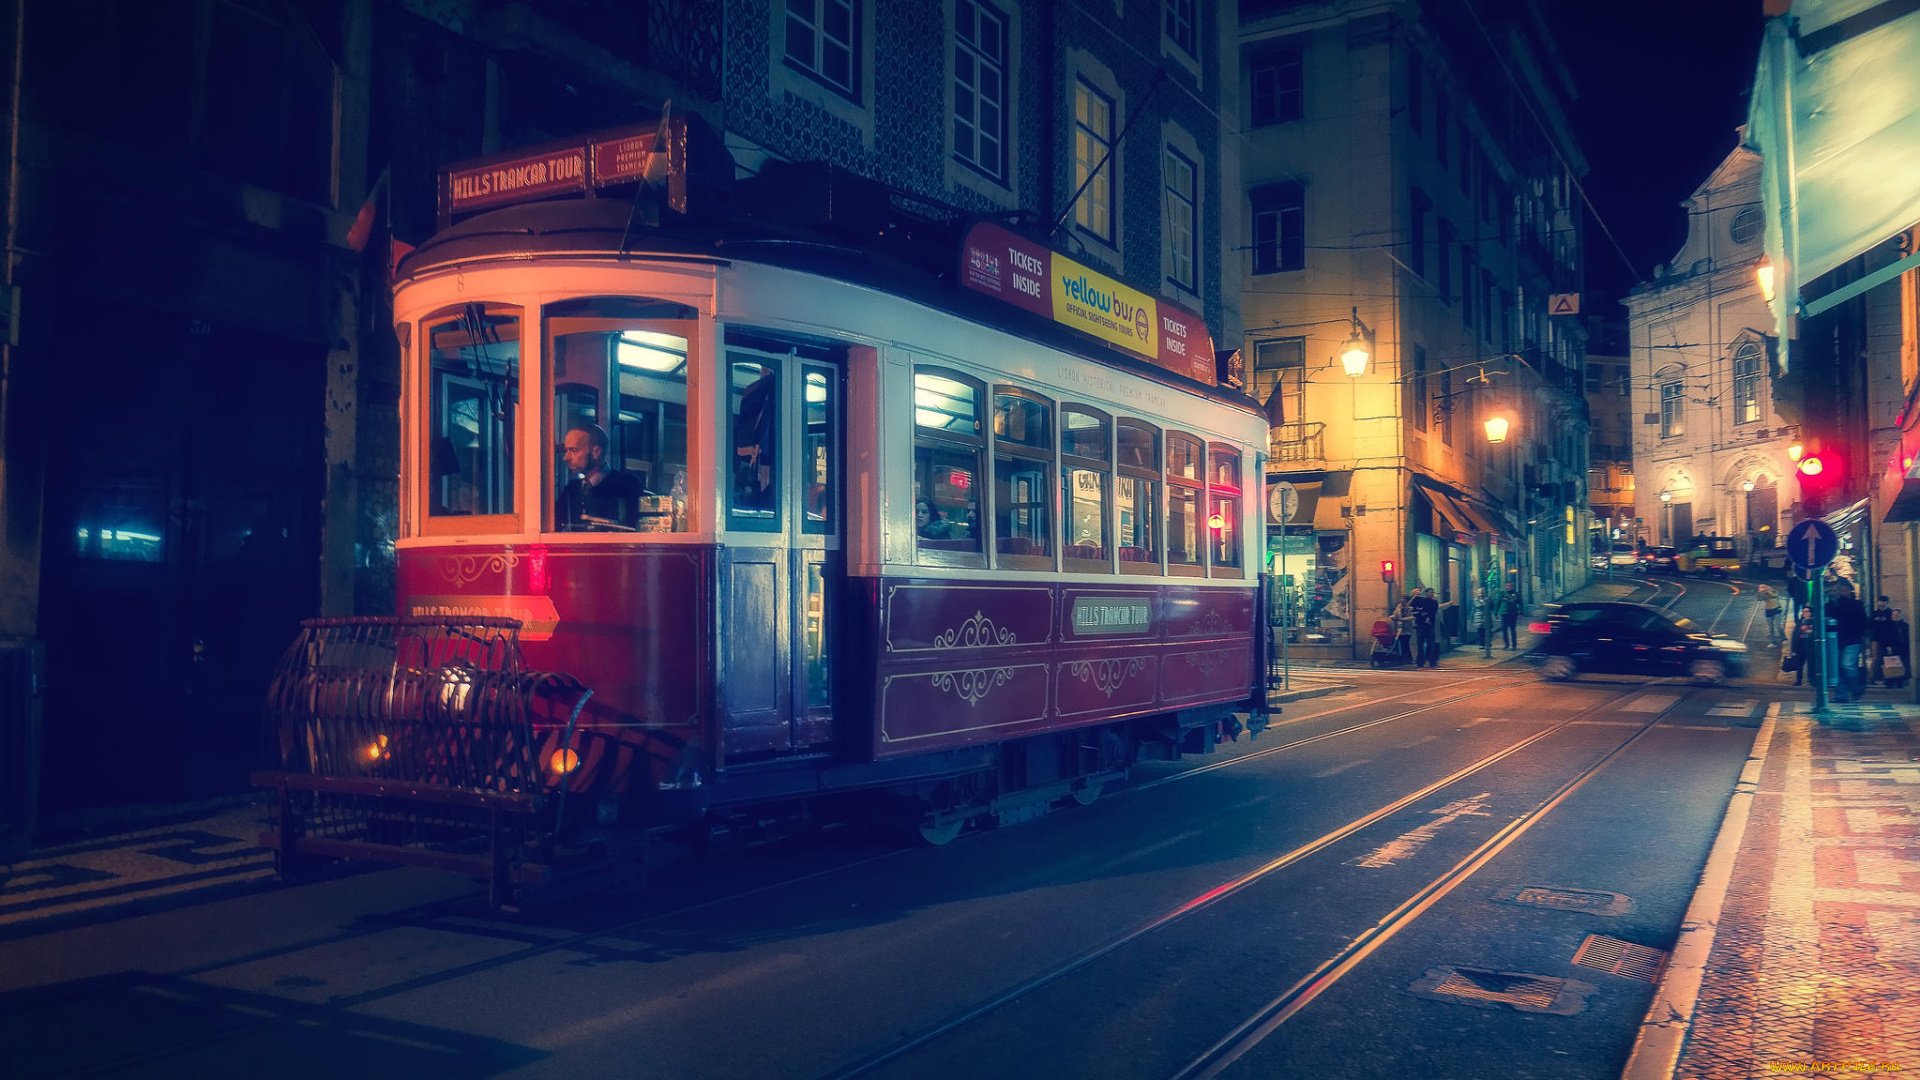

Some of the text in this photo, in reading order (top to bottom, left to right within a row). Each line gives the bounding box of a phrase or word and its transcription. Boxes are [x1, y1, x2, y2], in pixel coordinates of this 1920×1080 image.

[453, 174, 490, 200] HILLS
[548, 155, 583, 181] TOUR
[1008, 247, 1043, 277] TICKETS
[457, 273, 465, 293] 8
[1012, 272, 1041, 299] INSIDE
[1066, 302, 1134, 337] OFFICIAL SIGHTSEEING TOURS
[1112, 290, 1134, 322] bus
[1163, 316, 1187, 339] TICKETS
[1166, 336, 1186, 356] INSIDE
[1076, 606, 1099, 626] HILLS
[1131, 605, 1148, 625] TOUR
